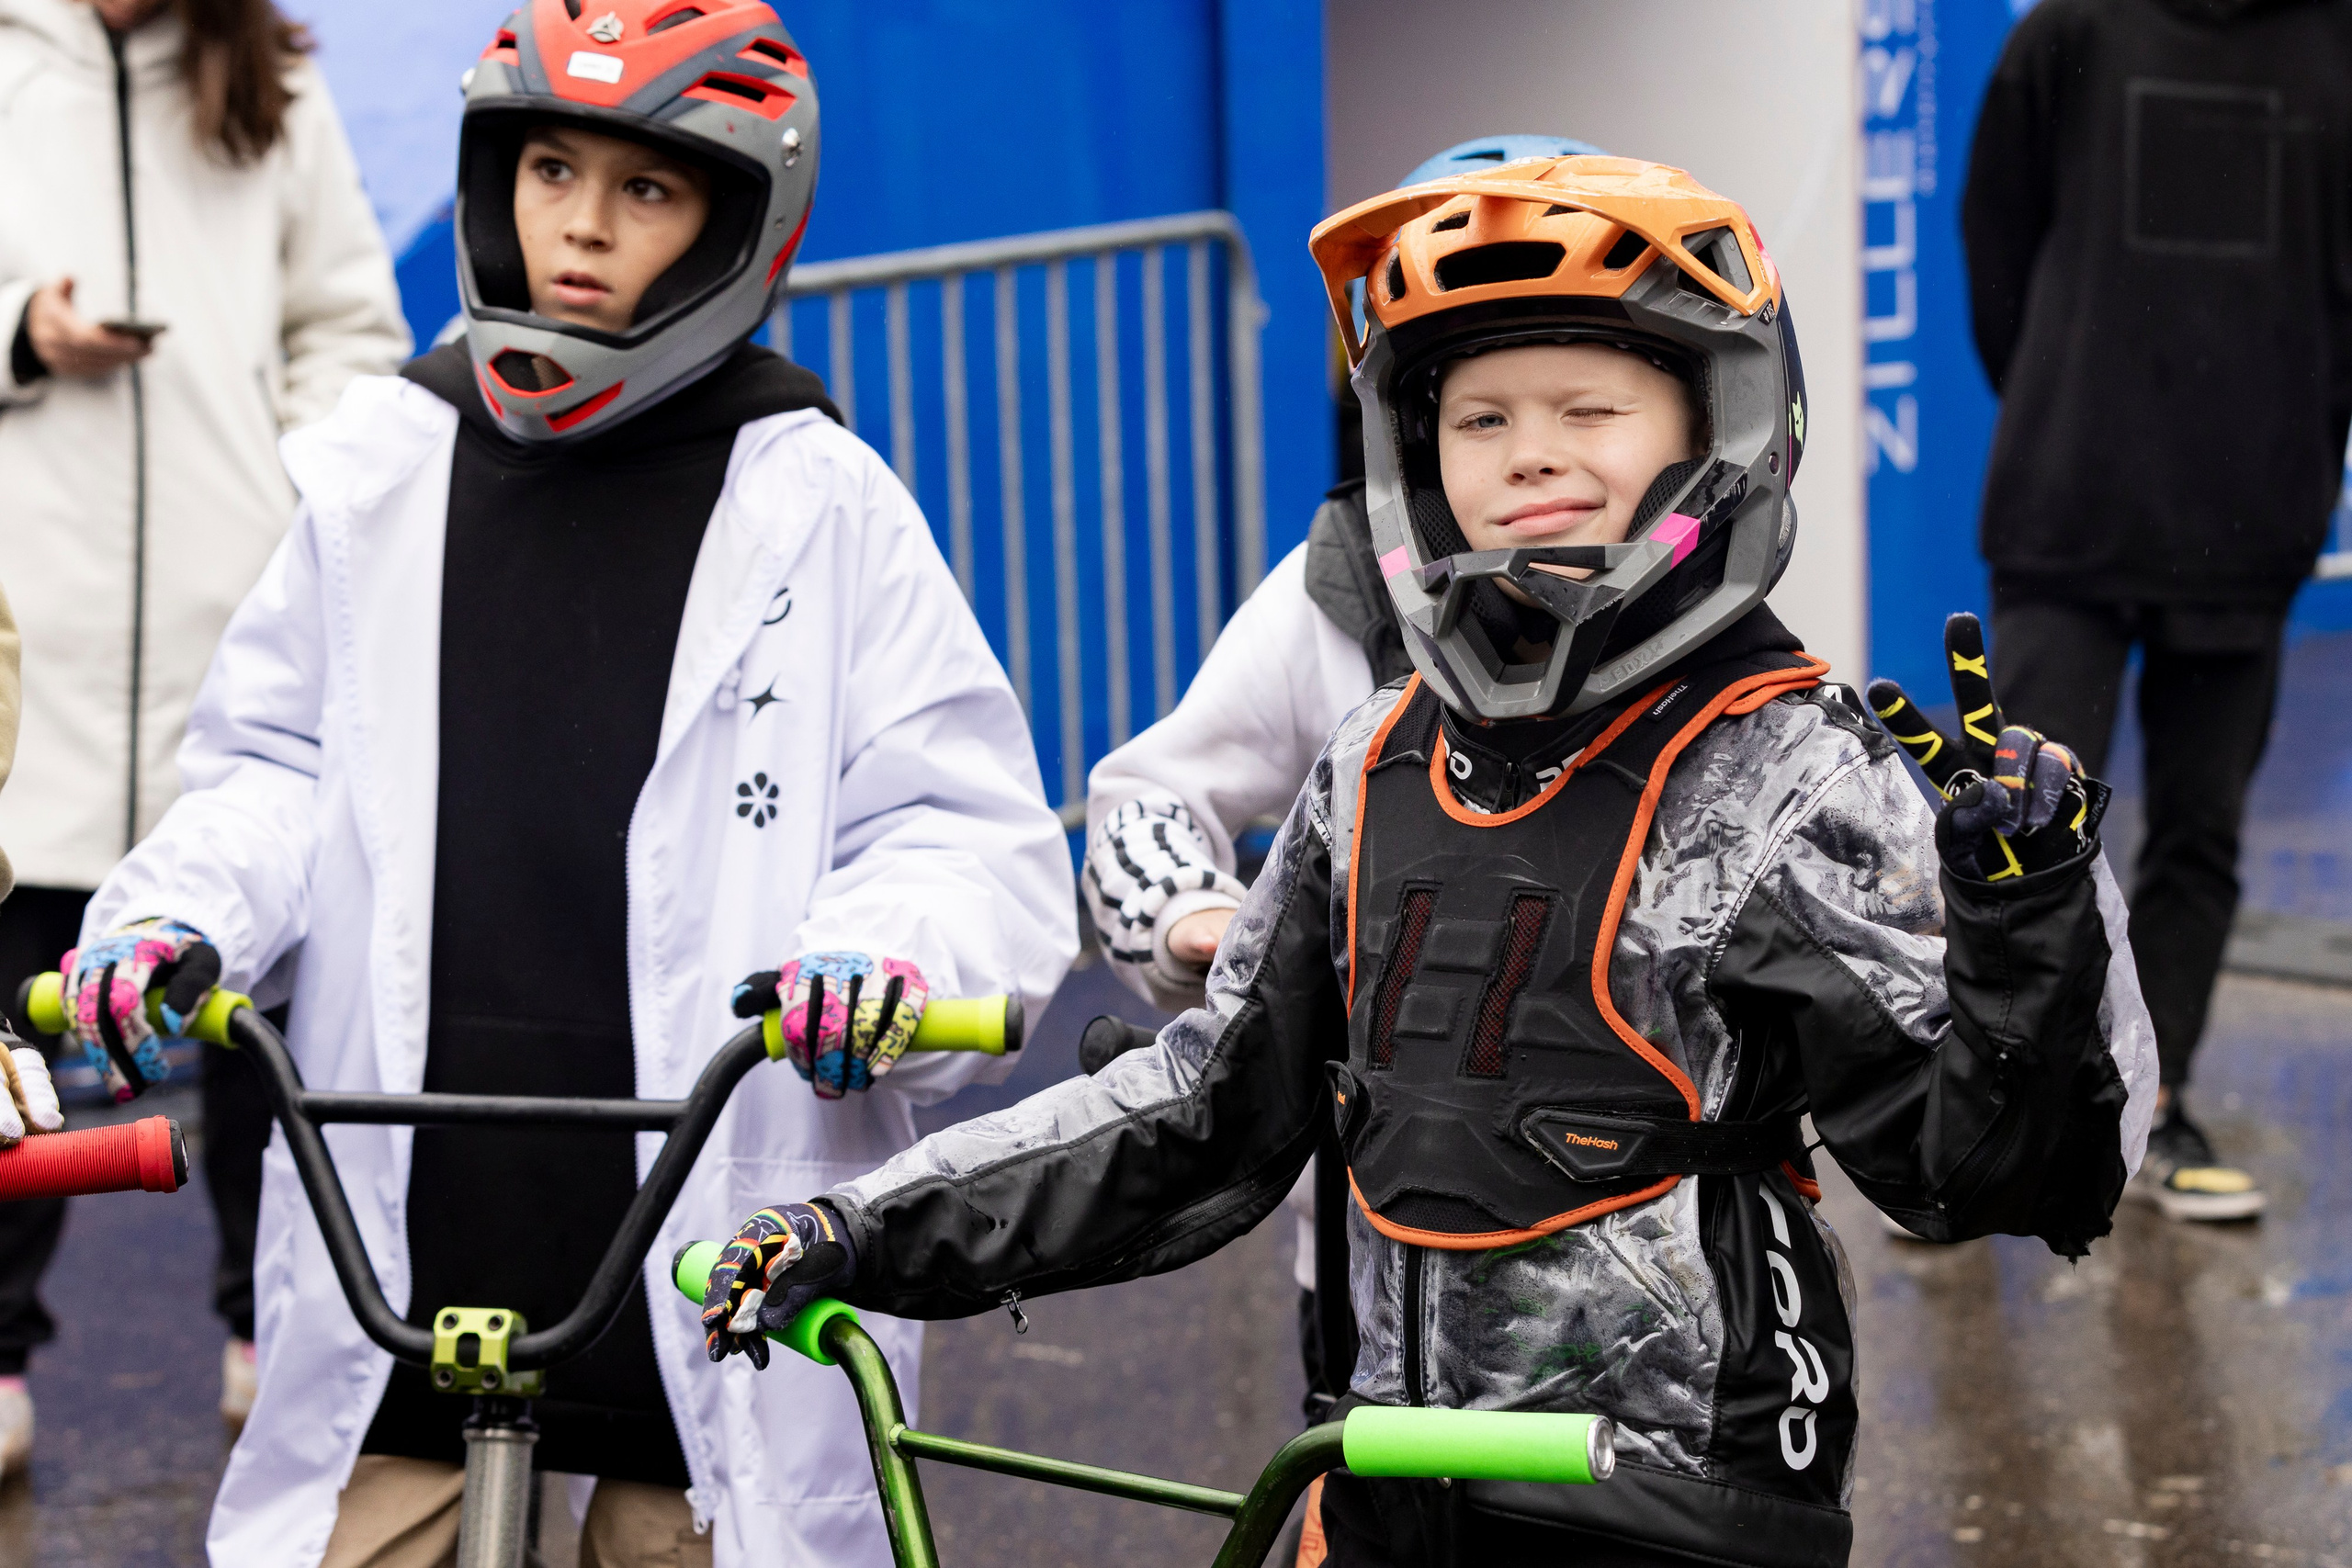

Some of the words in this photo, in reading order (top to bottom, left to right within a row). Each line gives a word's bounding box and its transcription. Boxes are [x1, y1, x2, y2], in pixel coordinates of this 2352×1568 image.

[1611, 652, 1650, 682] FOX
[1653, 684, 1688, 716] TheHash
[1566, 1133, 1618, 1151] TheHash
